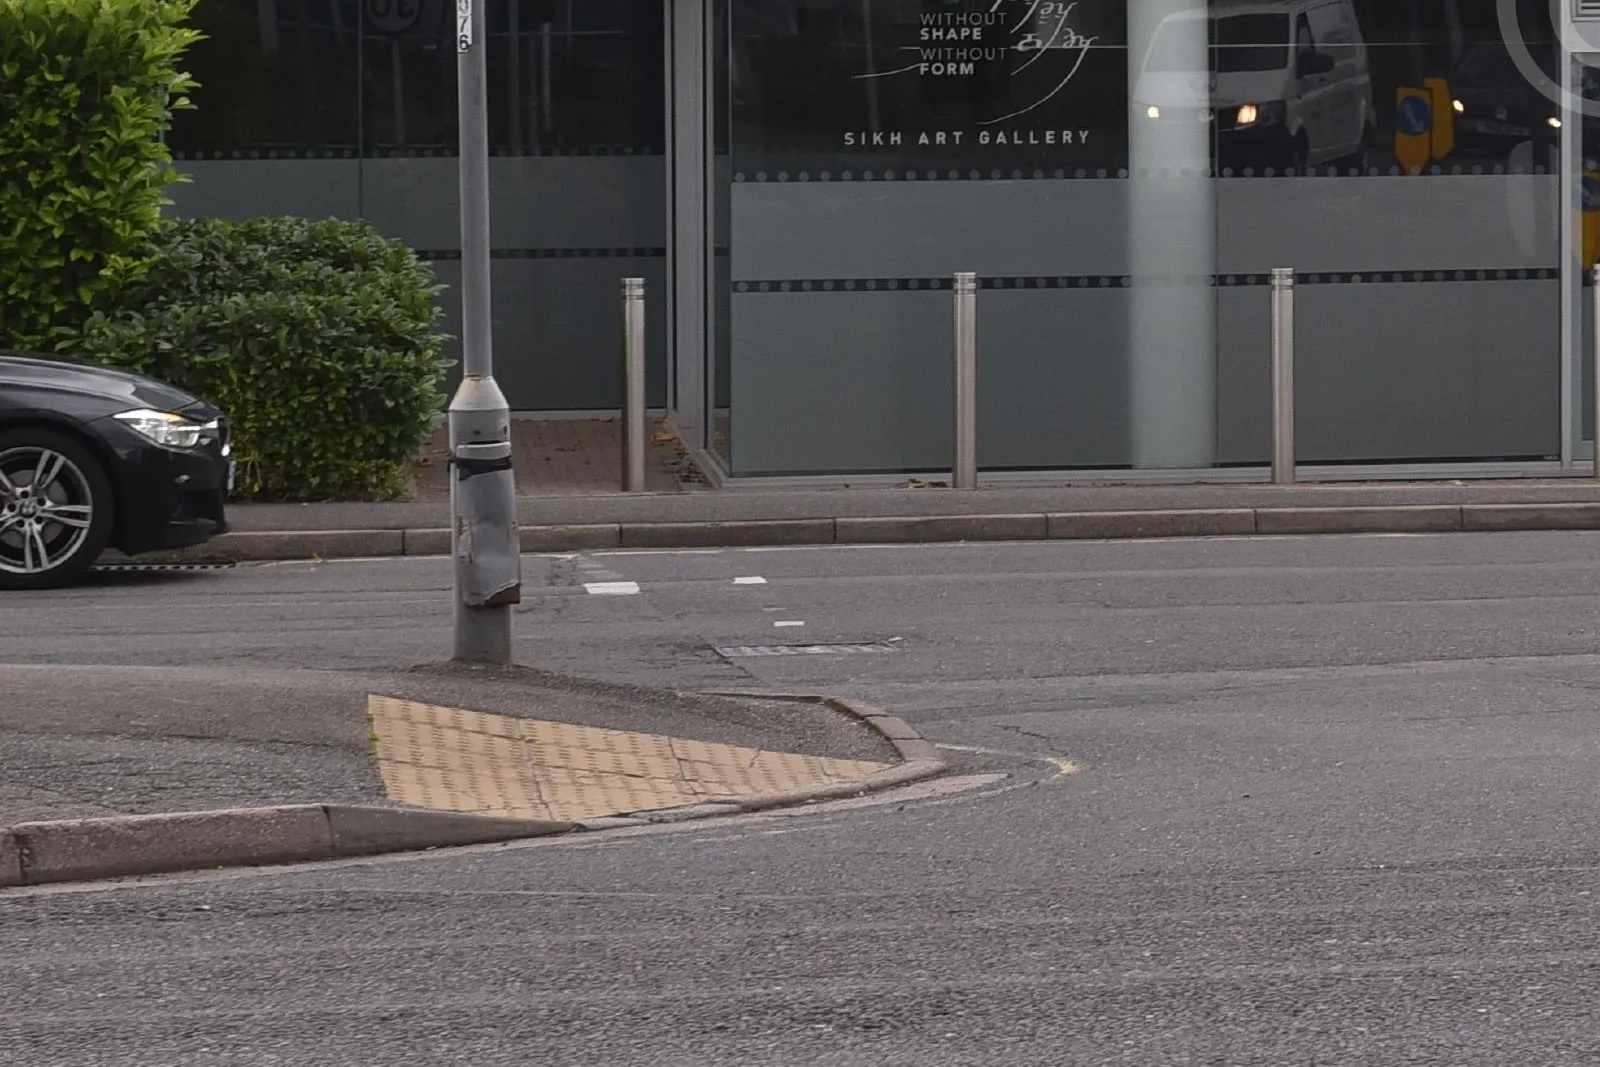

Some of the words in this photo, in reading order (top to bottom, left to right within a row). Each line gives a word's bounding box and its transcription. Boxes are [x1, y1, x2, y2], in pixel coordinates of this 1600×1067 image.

[920, 12, 1007, 26] WITHOUT
[920, 27, 982, 41] SHAPE
[920, 47, 1007, 61] WITHOUT
[920, 62, 974, 75] FORM
[844, 132, 901, 146] SIKH
[918, 131, 963, 146] ART
[979, 130, 1090, 145] GALLERY
